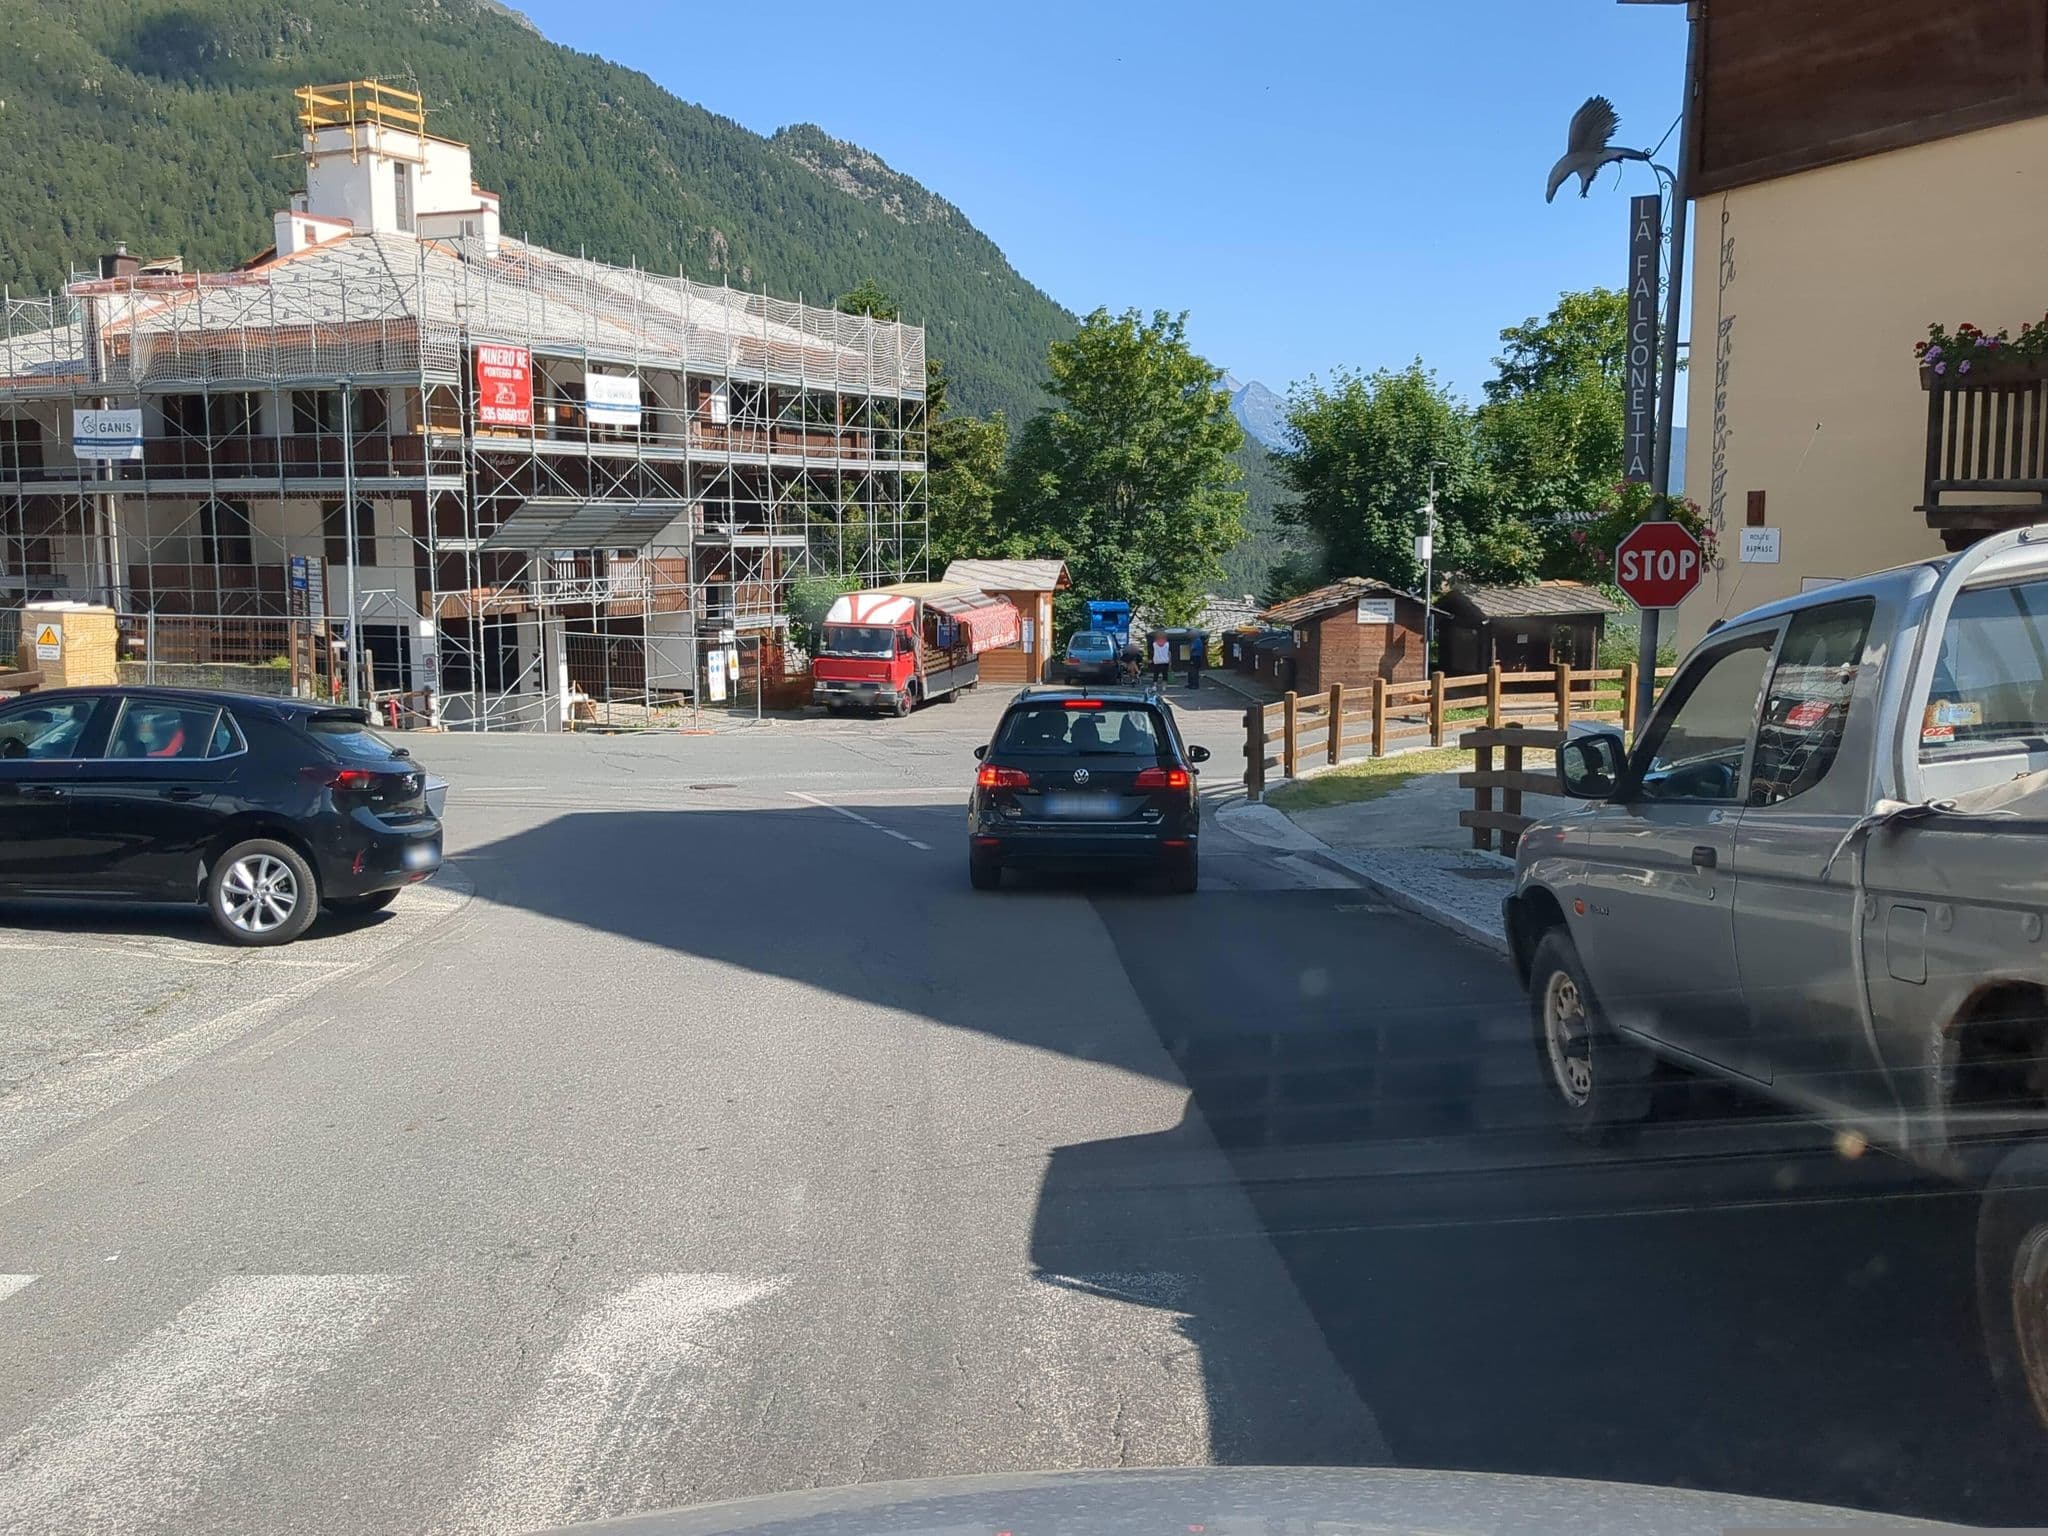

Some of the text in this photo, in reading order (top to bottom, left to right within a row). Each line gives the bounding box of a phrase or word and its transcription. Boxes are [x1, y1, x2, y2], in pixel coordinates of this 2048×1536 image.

[1628, 199, 1652, 476] LA FALCONETTA
[99, 422, 132, 433] GANIS
[1622, 550, 1696, 581] STOP
